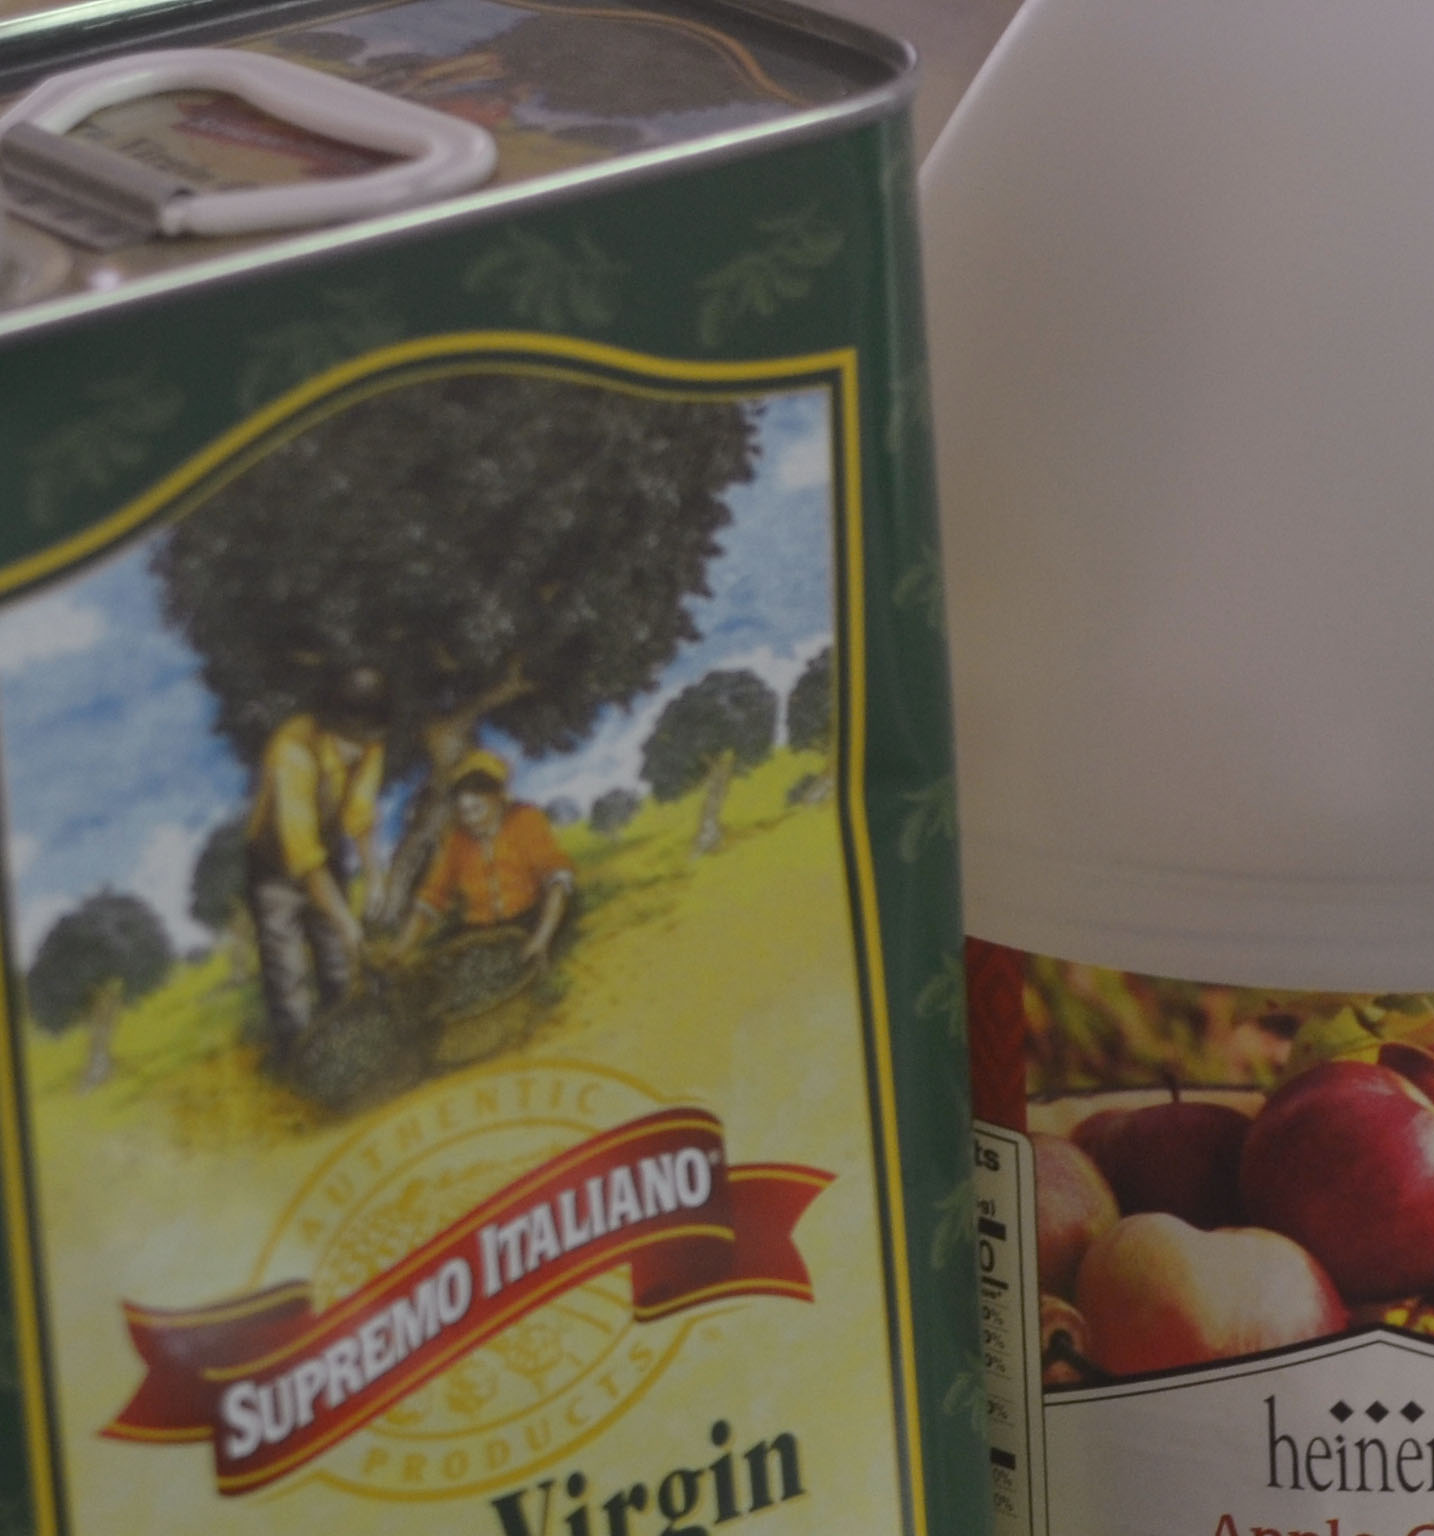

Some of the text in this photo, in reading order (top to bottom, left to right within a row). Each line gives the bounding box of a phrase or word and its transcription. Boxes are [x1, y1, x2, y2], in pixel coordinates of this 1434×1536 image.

[301, 1078, 597, 1235] AUTHENTIC
[221, 1148, 714, 1459] SUPREMO ITALIANO
[364, 1341, 653, 1480] PRODUCTS
